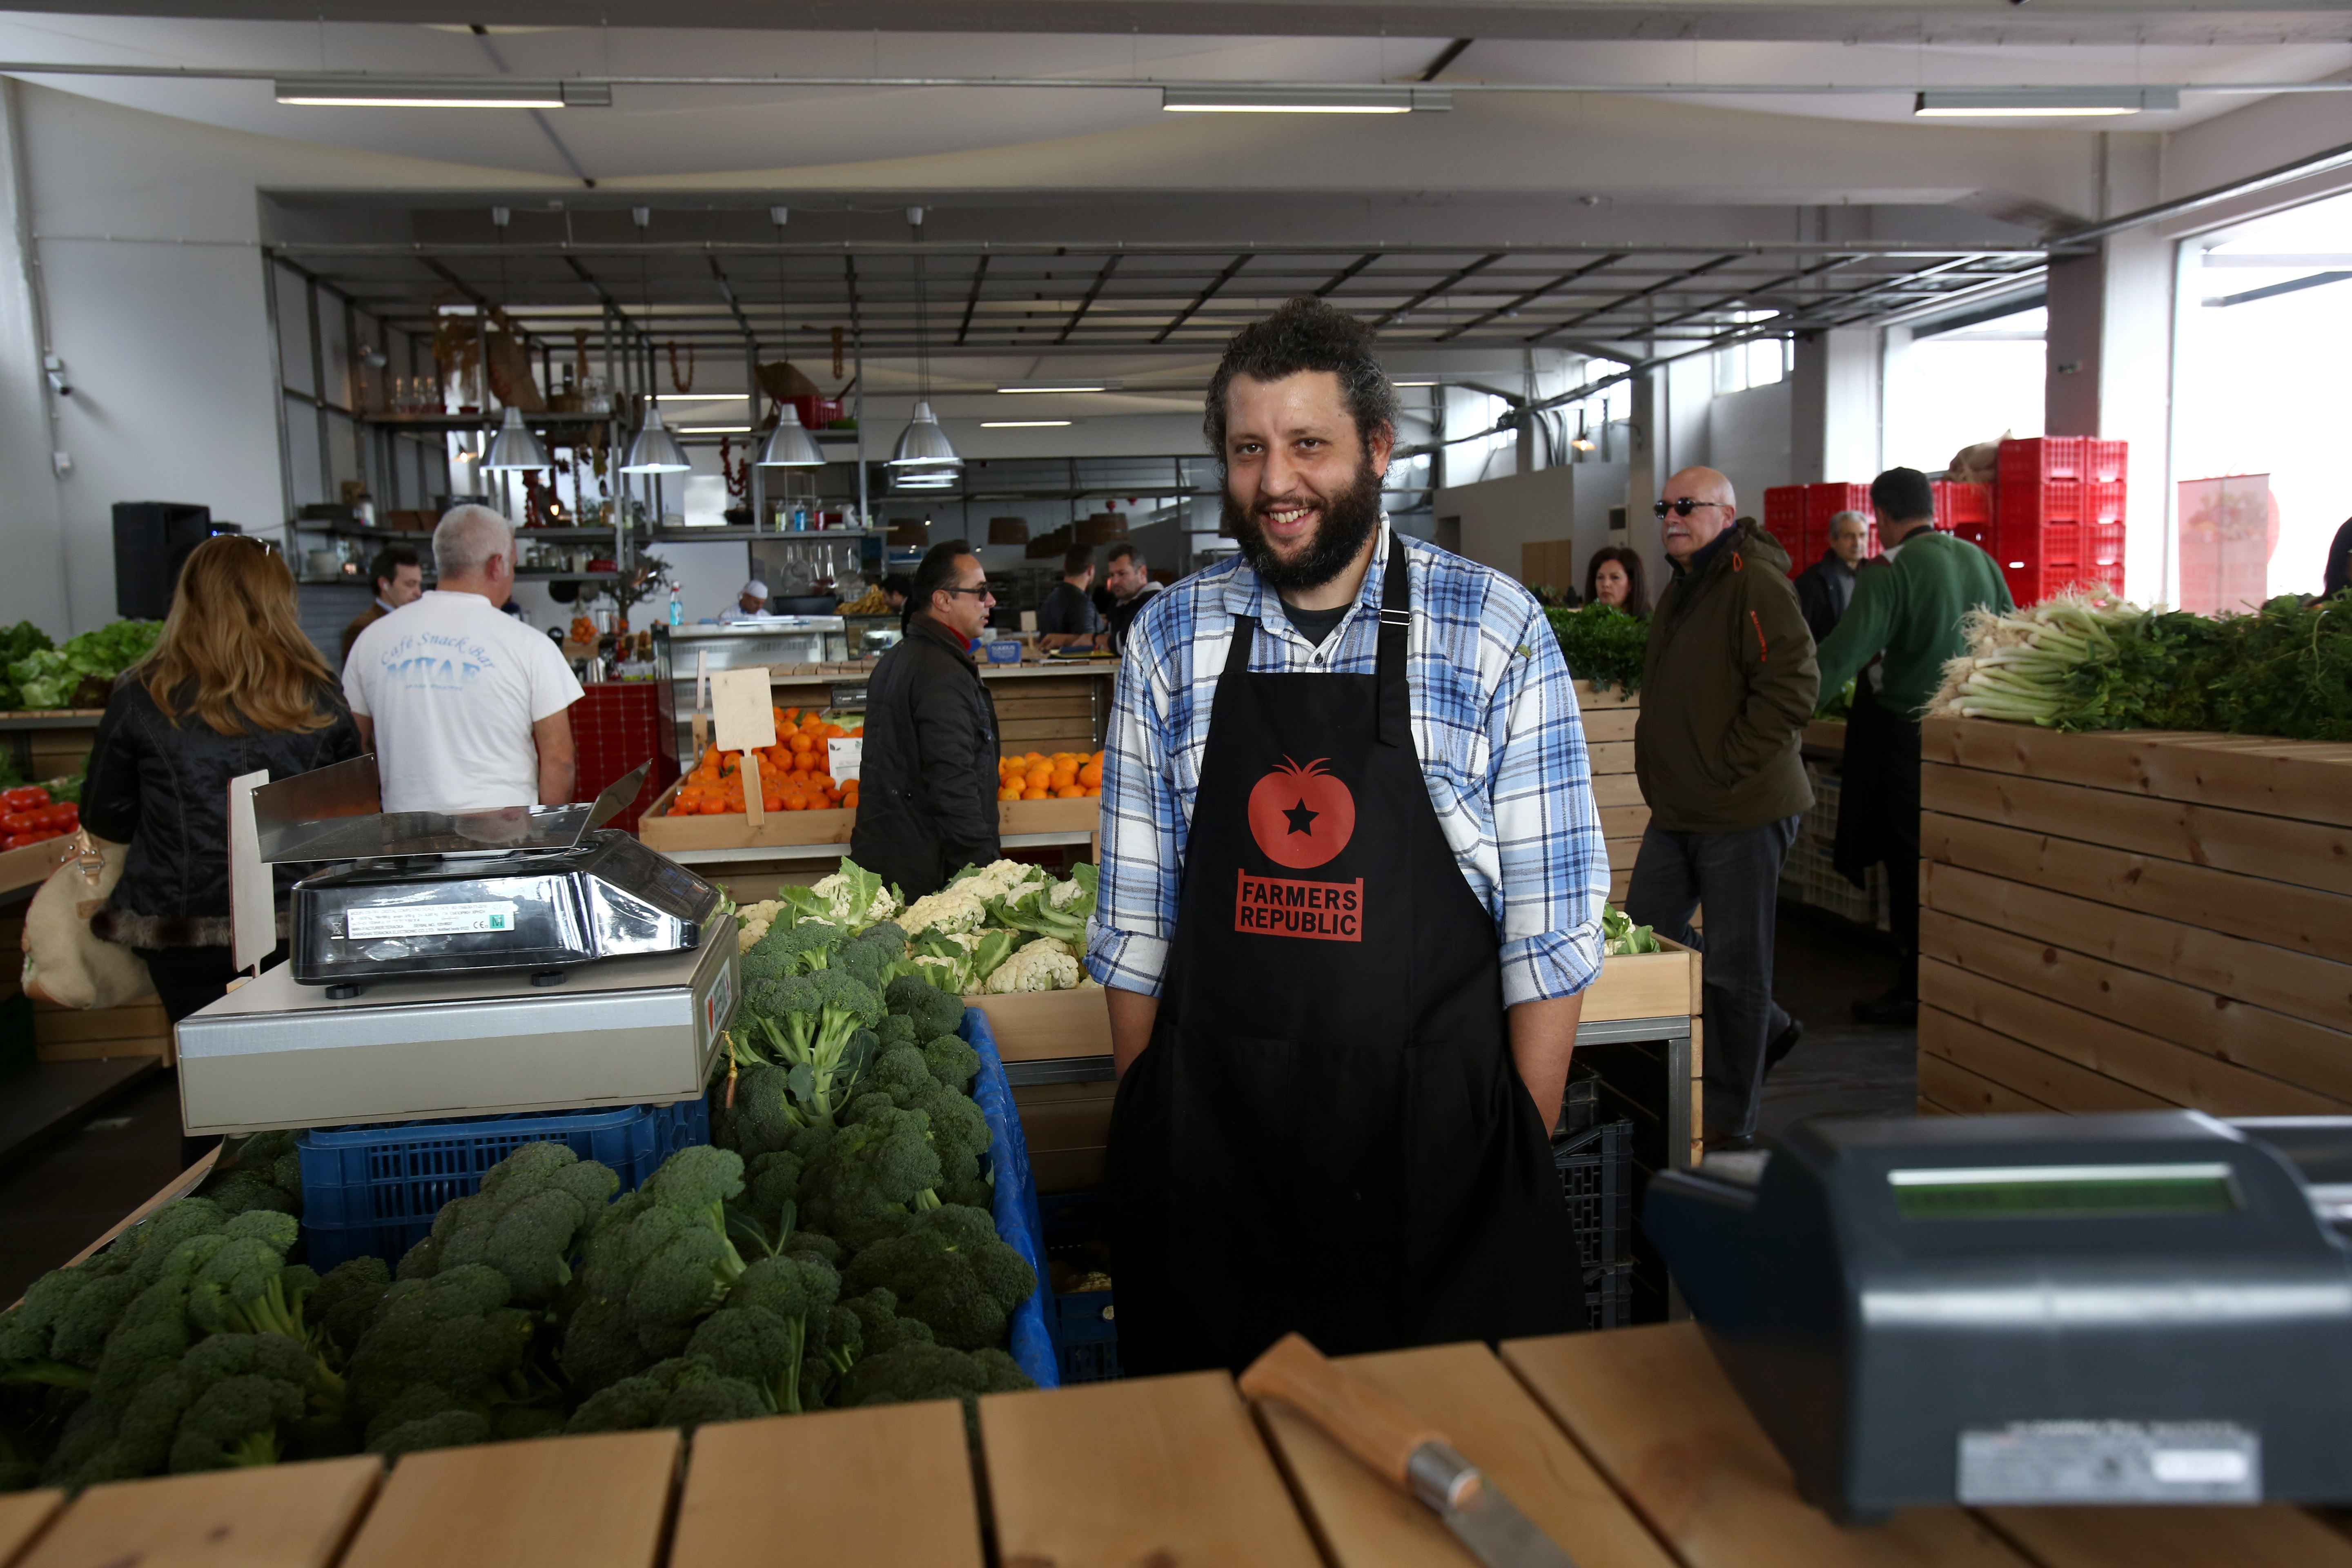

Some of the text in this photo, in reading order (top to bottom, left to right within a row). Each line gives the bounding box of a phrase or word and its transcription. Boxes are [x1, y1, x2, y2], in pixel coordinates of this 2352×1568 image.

[418, 633, 469, 653] Snack
[469, 646, 495, 668] Bar
[1242, 882, 1357, 911] FARMERS
[492, 916, 502, 926] M
[1241, 906, 1356, 935] REPUBLIC
